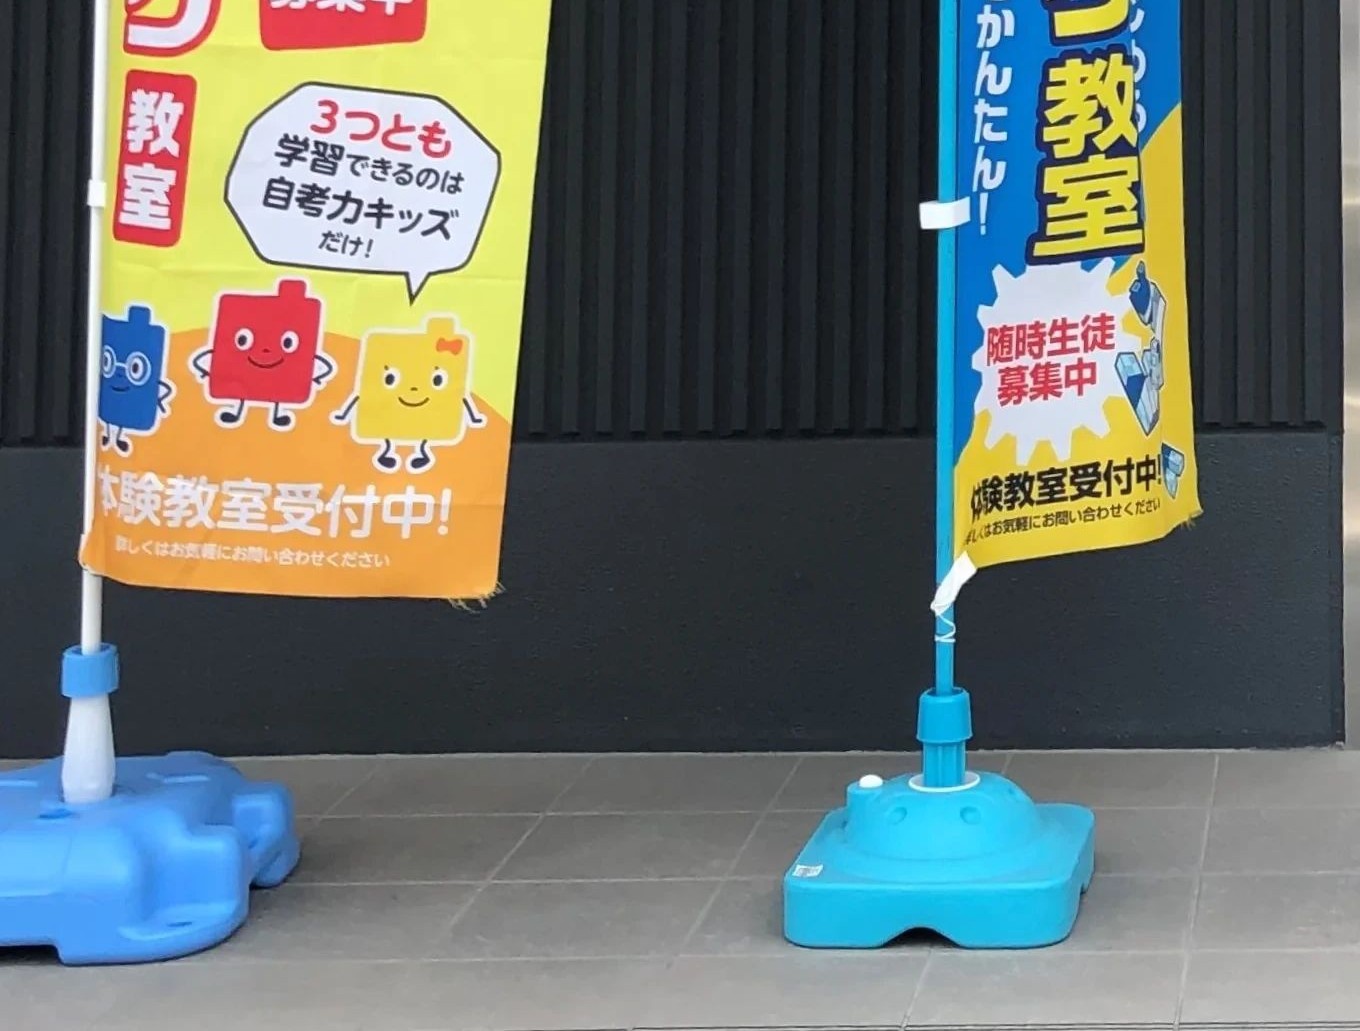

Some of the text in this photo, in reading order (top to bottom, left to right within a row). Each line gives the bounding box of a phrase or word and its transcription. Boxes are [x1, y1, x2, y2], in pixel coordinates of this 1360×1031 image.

[118, 87, 186, 232] 教室
[309, 99, 452, 159] 3つとも
[1025, 44, 1146, 268] 教室
[274, 132, 465, 195] 学習できるのは
[262, 175, 461, 241] 自考力キッズ
[986, 313, 1116, 367] 随時生徒
[997, 356, 1099, 406] 募集中
